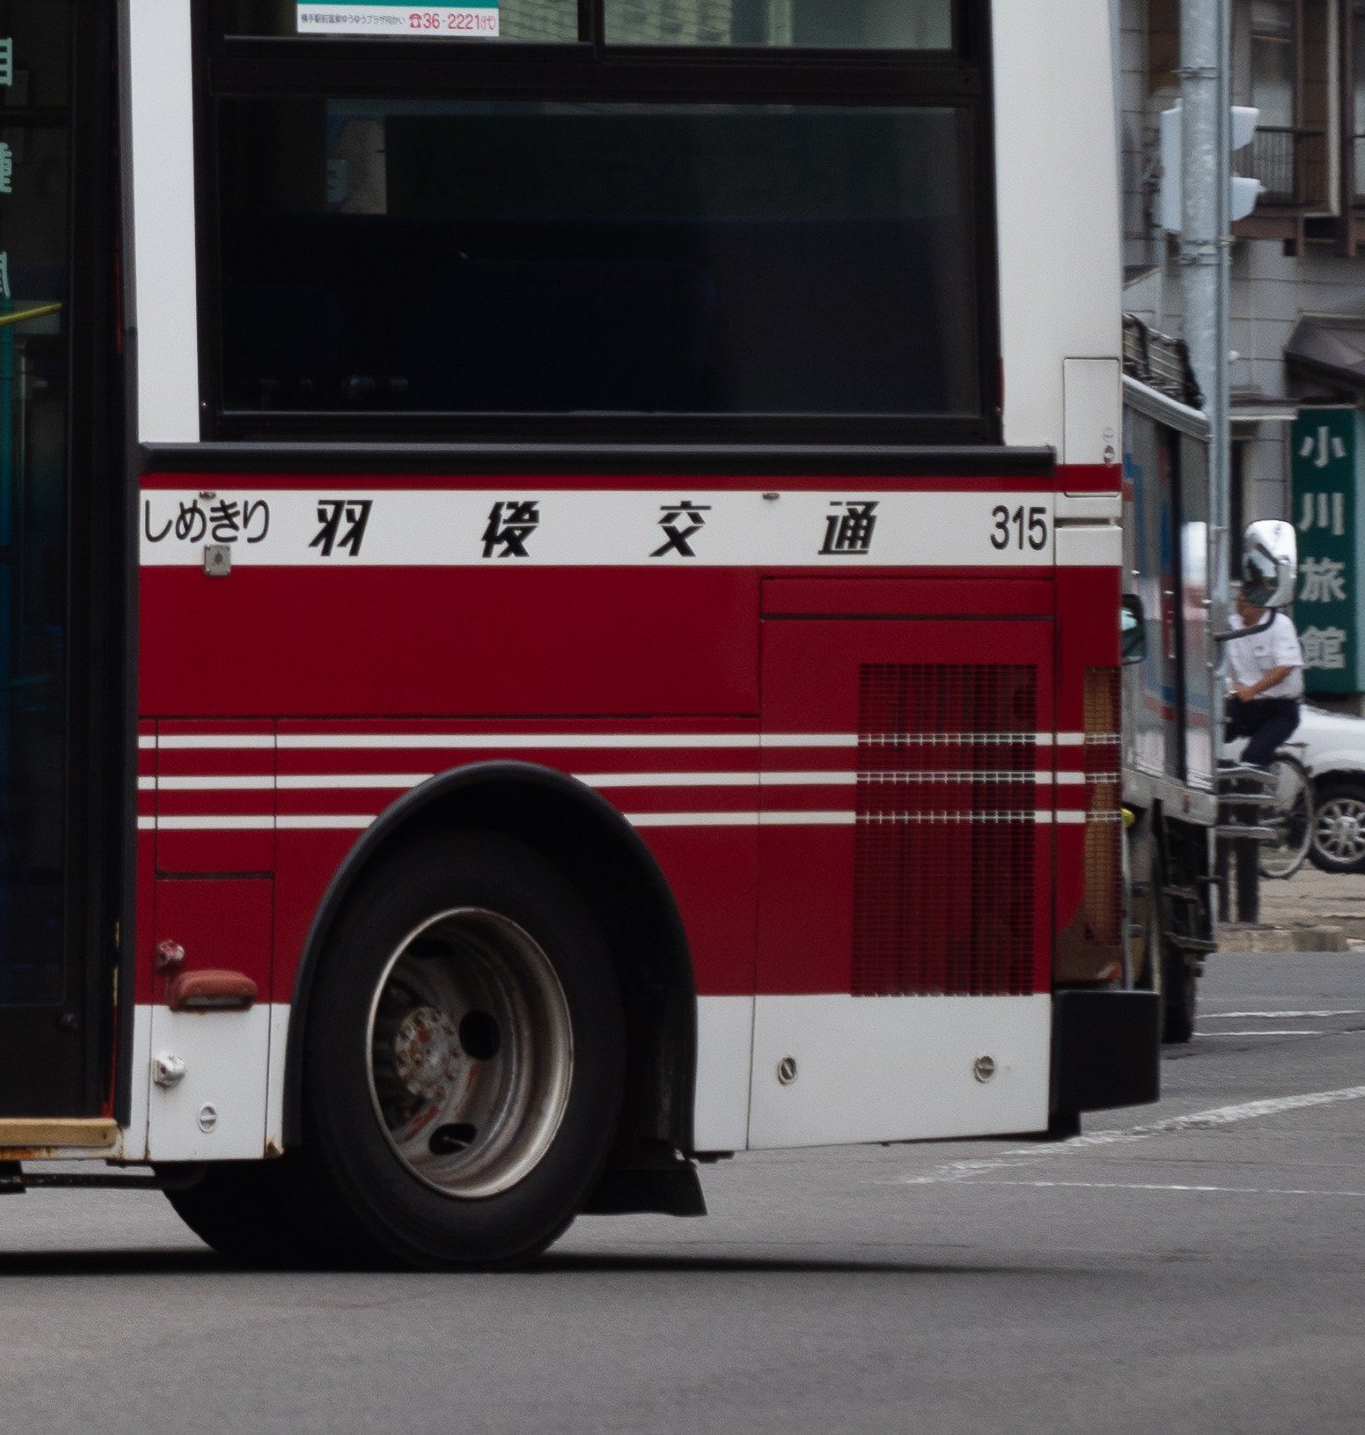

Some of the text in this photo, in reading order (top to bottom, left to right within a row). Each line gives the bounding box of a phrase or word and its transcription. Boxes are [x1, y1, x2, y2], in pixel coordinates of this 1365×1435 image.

[143, 498, 270, 545] しめきり
[308, 498, 880, 559] 羽後交通
[989, 504, 1048, 552] 315
[1298, 425, 1348, 670] 小川旅館
